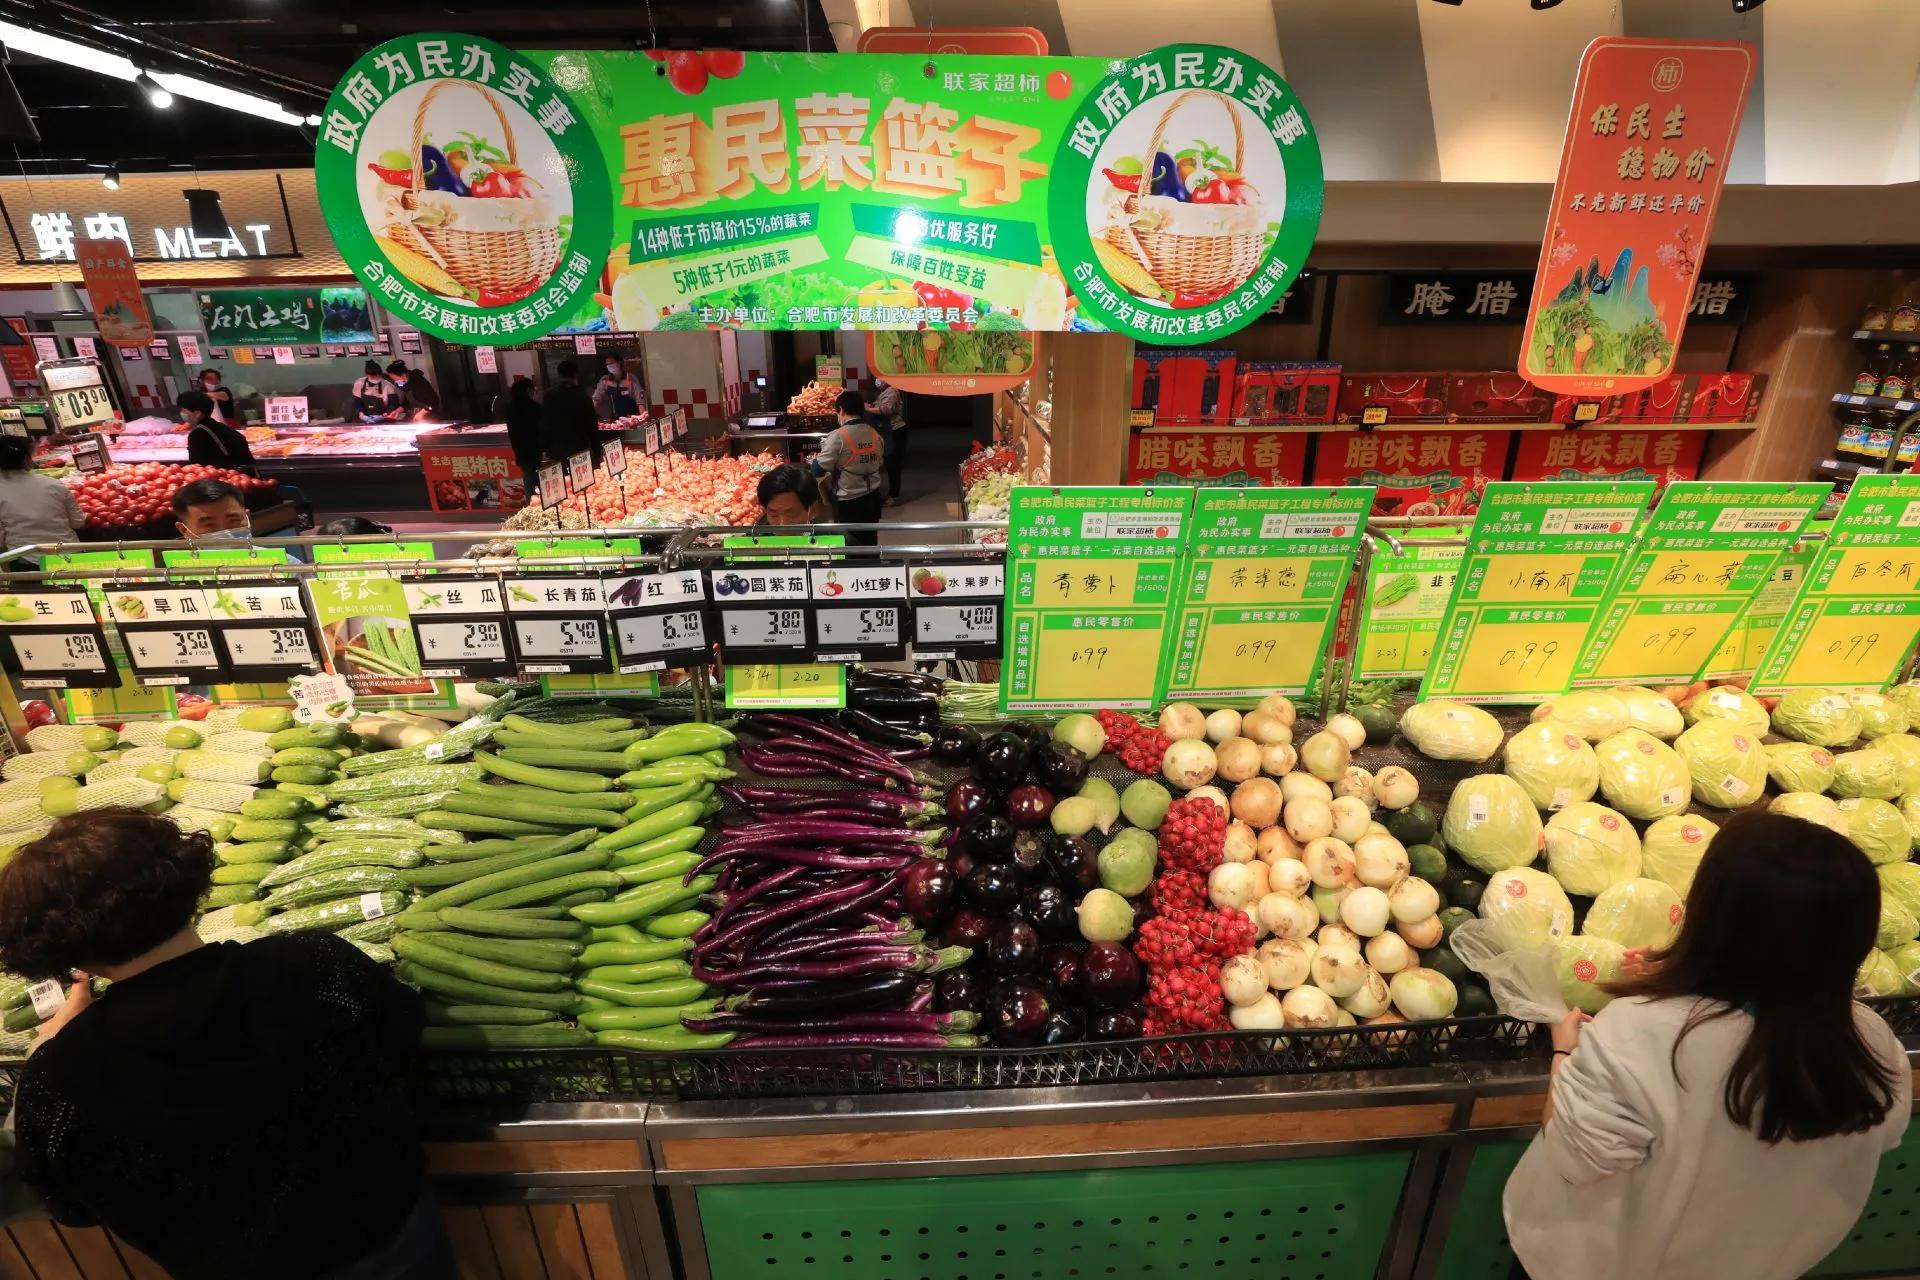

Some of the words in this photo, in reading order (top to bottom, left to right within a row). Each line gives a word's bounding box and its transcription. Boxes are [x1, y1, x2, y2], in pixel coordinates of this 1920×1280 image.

[324, 40, 577, 155] 政府为民办实事
[1068, 52, 1308, 160] 政府为民办实事
[1591, 103, 1688, 139] 保民生
[619, 92, 1049, 208] 惠民菜篮子
[1617, 147, 1715, 182] 稳物价
[1570, 193, 1706, 215] 不光新鲜还平价
[154, 223, 271, 259] MEAT
[637, 211, 813, 256] 14种低于市场价15%的蔬菜
[896, 218, 998, 250] 优服务好
[672, 248, 792, 295] 5种低于1元的蔬菜
[890, 249, 987, 291] 保障百姓受益
[363, 250, 592, 336] 合肥市发展和改革委员会监制
[1073, 256, 1289, 336] 合肥市发展和改革委员会监制
[1136, 434, 1284, 471] 腊味飘香
[1344, 433, 1488, 469] 腊味飘香
[1543, 432, 1685, 468] 腊味飘香
[1035, 515, 1056, 525] 政府
[1216, 517, 1238, 526] 政府
[1500, 511, 1522, 521] 政府
[1655, 521, 1706, 530] 为民办实事
[1676, 509, 1698, 519] 政府
[1018, 527, 1073, 537] 为民办实事
[1199, 528, 1252, 538] 为民办实事
[1482, 523, 1533, 533] 为民办实事
[647, 578, 699, 597] 红茄
[751, 576, 804, 592] 圆紫茄
[851, 577, 905, 592] 小红萝卜
[949, 575, 1004, 588] 水果萝卜
[1509, 571, 1575, 596] 小南瓜
[245, 597, 298, 612] 苦瓜
[447, 588, 497, 604] 丝瓜
[545, 587, 597, 602] 长青茄
[35, 600, 87, 615] 生瓜
[959, 607, 994, 630] 4.00
[1240, 610, 1300, 621] 惠民零售价
[1508, 610, 1567, 621] 惠民零售价
[662, 613, 698, 640] 6.70
[767, 611, 800, 635] 3.80
[860, 609, 895, 633] 5.90
[1072, 616, 1135, 628] 惠民零售价
[172, 632, 207, 656] 3.50
[269, 629, 304, 654] 3.90
[464, 624, 498, 648] 2.90
[561, 622, 596, 645] 5.40
[1644, 628, 1697, 656] 0.99
[1072, 647, 1108, 671] 0.99
[1235, 640, 1277, 663] 0.99
[1499, 641, 1559, 678] 0.99
[1828, 633, 1880, 665] 0.99
[793, 671, 821, 682] 2.20
